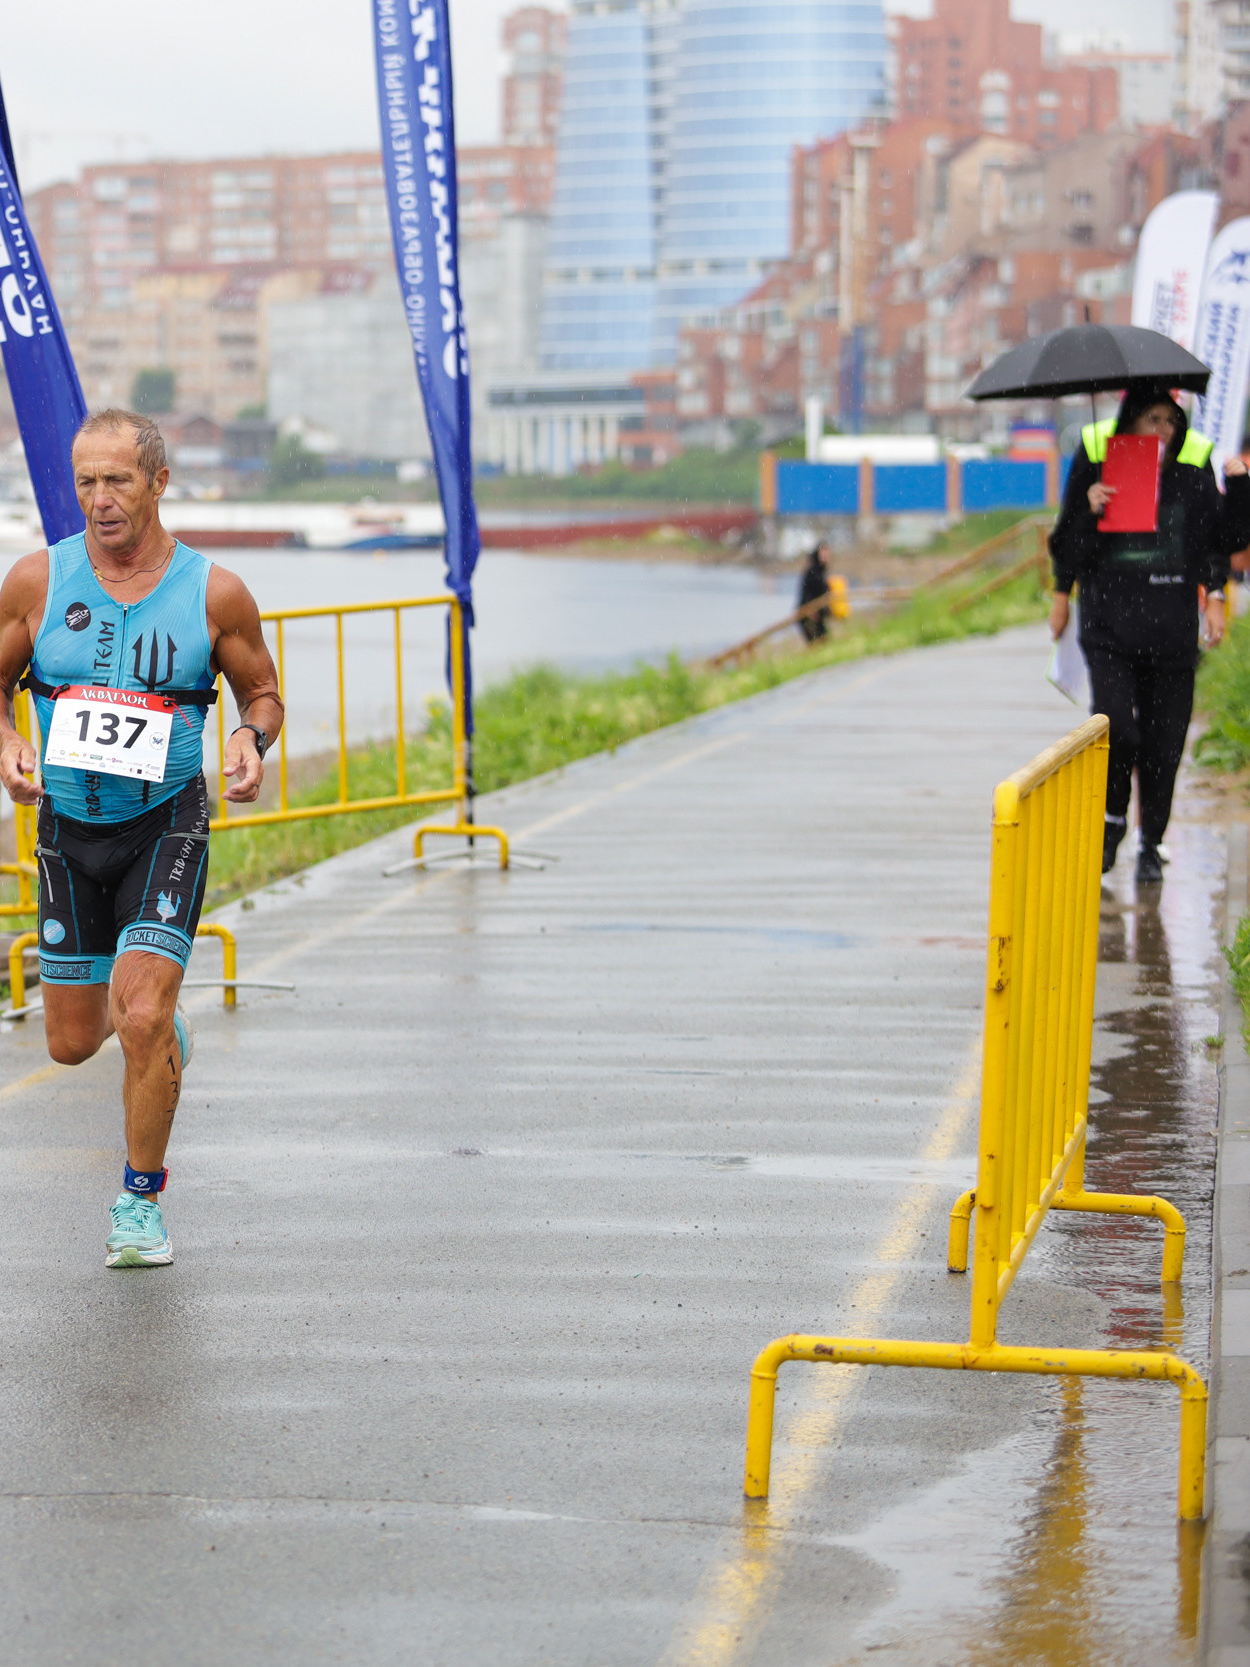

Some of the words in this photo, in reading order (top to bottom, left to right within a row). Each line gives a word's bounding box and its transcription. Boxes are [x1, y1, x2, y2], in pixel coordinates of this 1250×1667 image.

[75, 709, 148, 749] 137
[85, 770, 103, 818] TRIDEN
[94, 620, 116, 670] TEAM
[169, 837, 195, 882] TRIDENT
